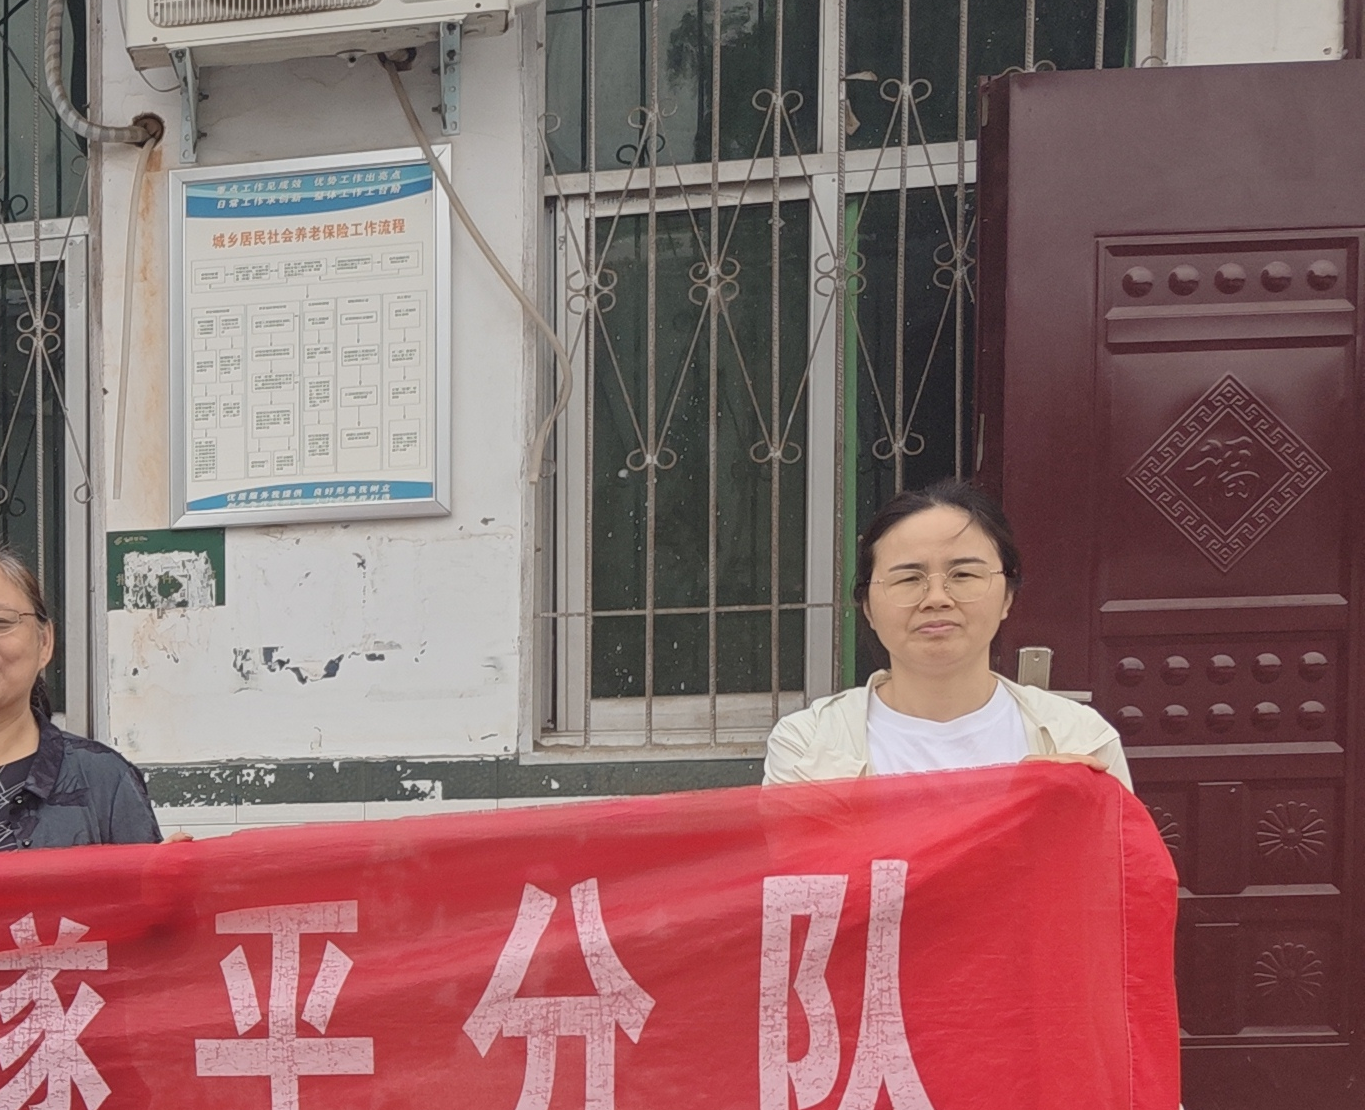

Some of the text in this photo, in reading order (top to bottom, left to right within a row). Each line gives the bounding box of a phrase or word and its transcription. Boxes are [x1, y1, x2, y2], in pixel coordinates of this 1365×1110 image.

[314, 169, 402, 187] 优势工作出亮点
[211, 218, 407, 249] 城乡居民社会养老保险工作流程
